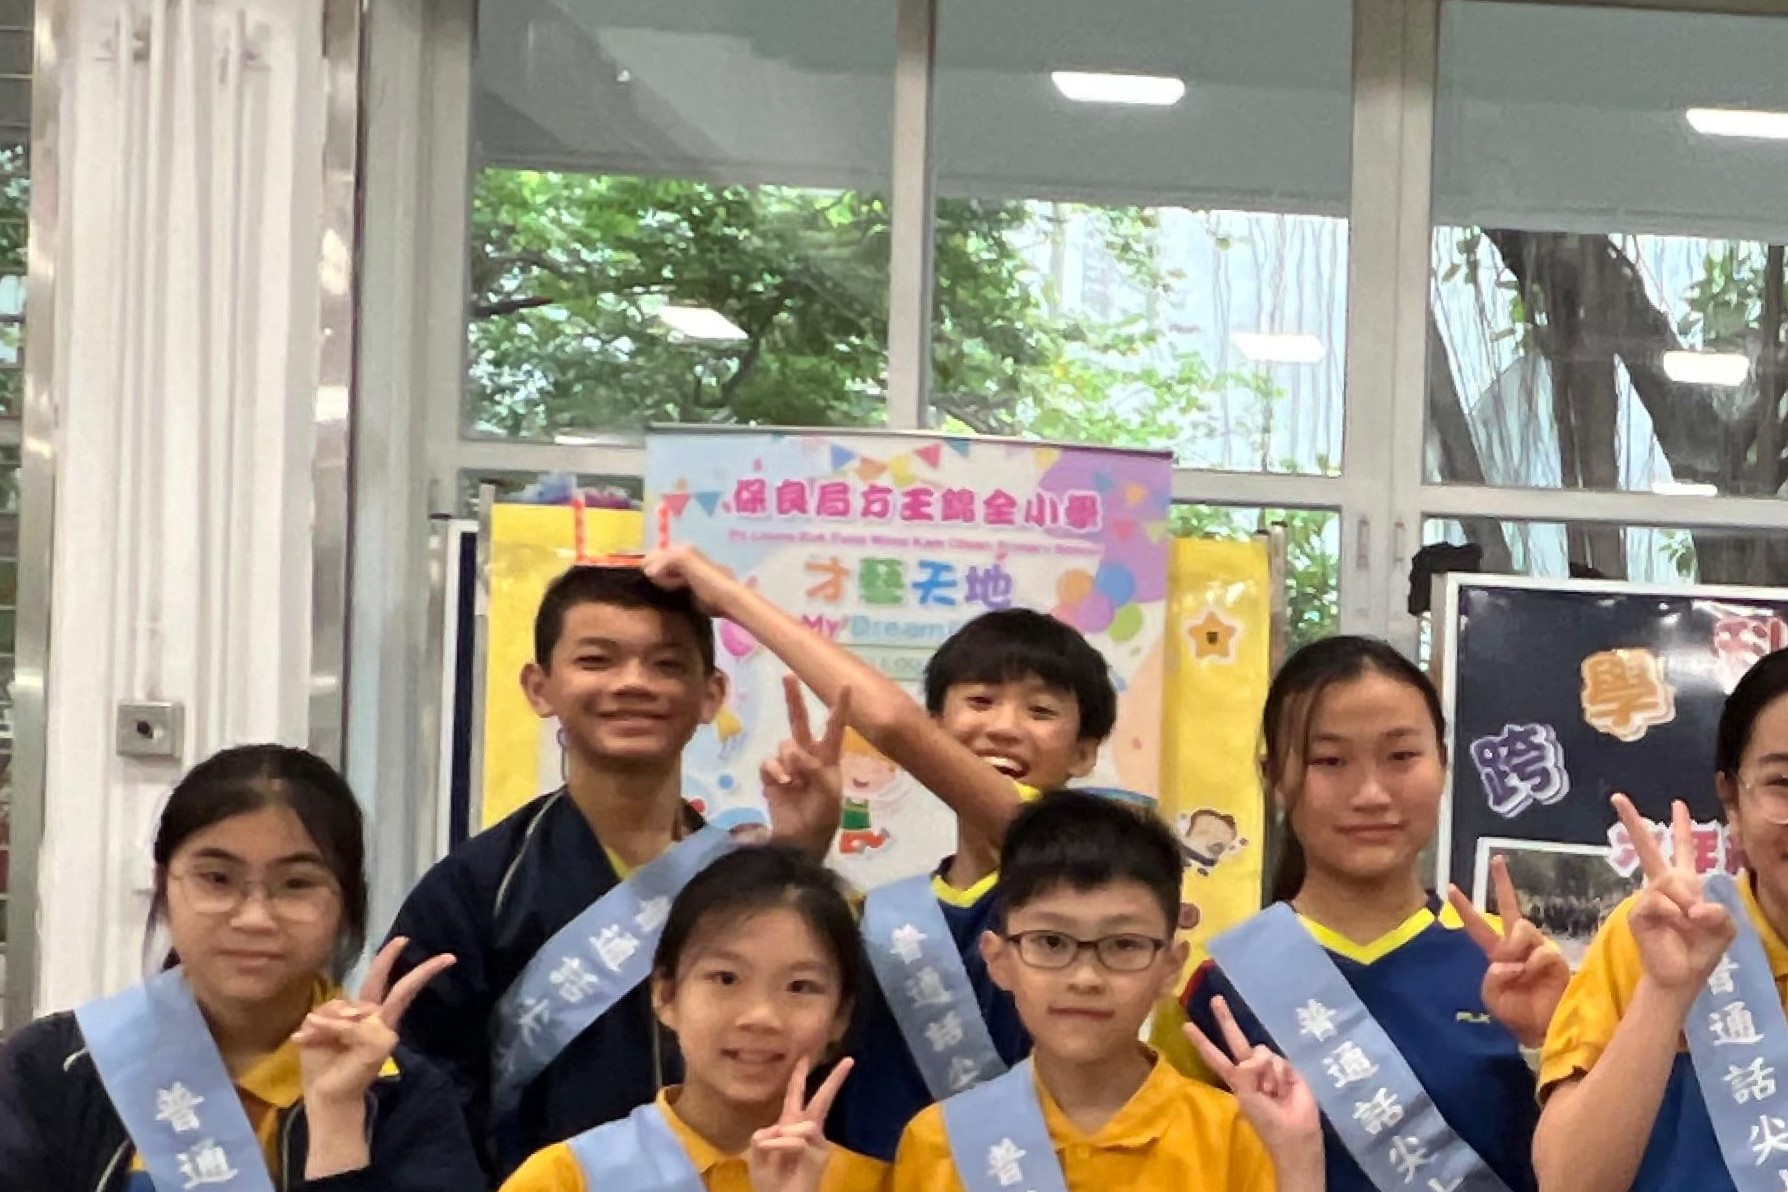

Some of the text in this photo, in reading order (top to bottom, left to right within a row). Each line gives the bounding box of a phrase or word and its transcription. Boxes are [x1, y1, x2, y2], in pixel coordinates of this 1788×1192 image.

[733, 478, 1100, 530] 保良局方王錦全小學
[804, 556, 1013, 607] 才藝天地
